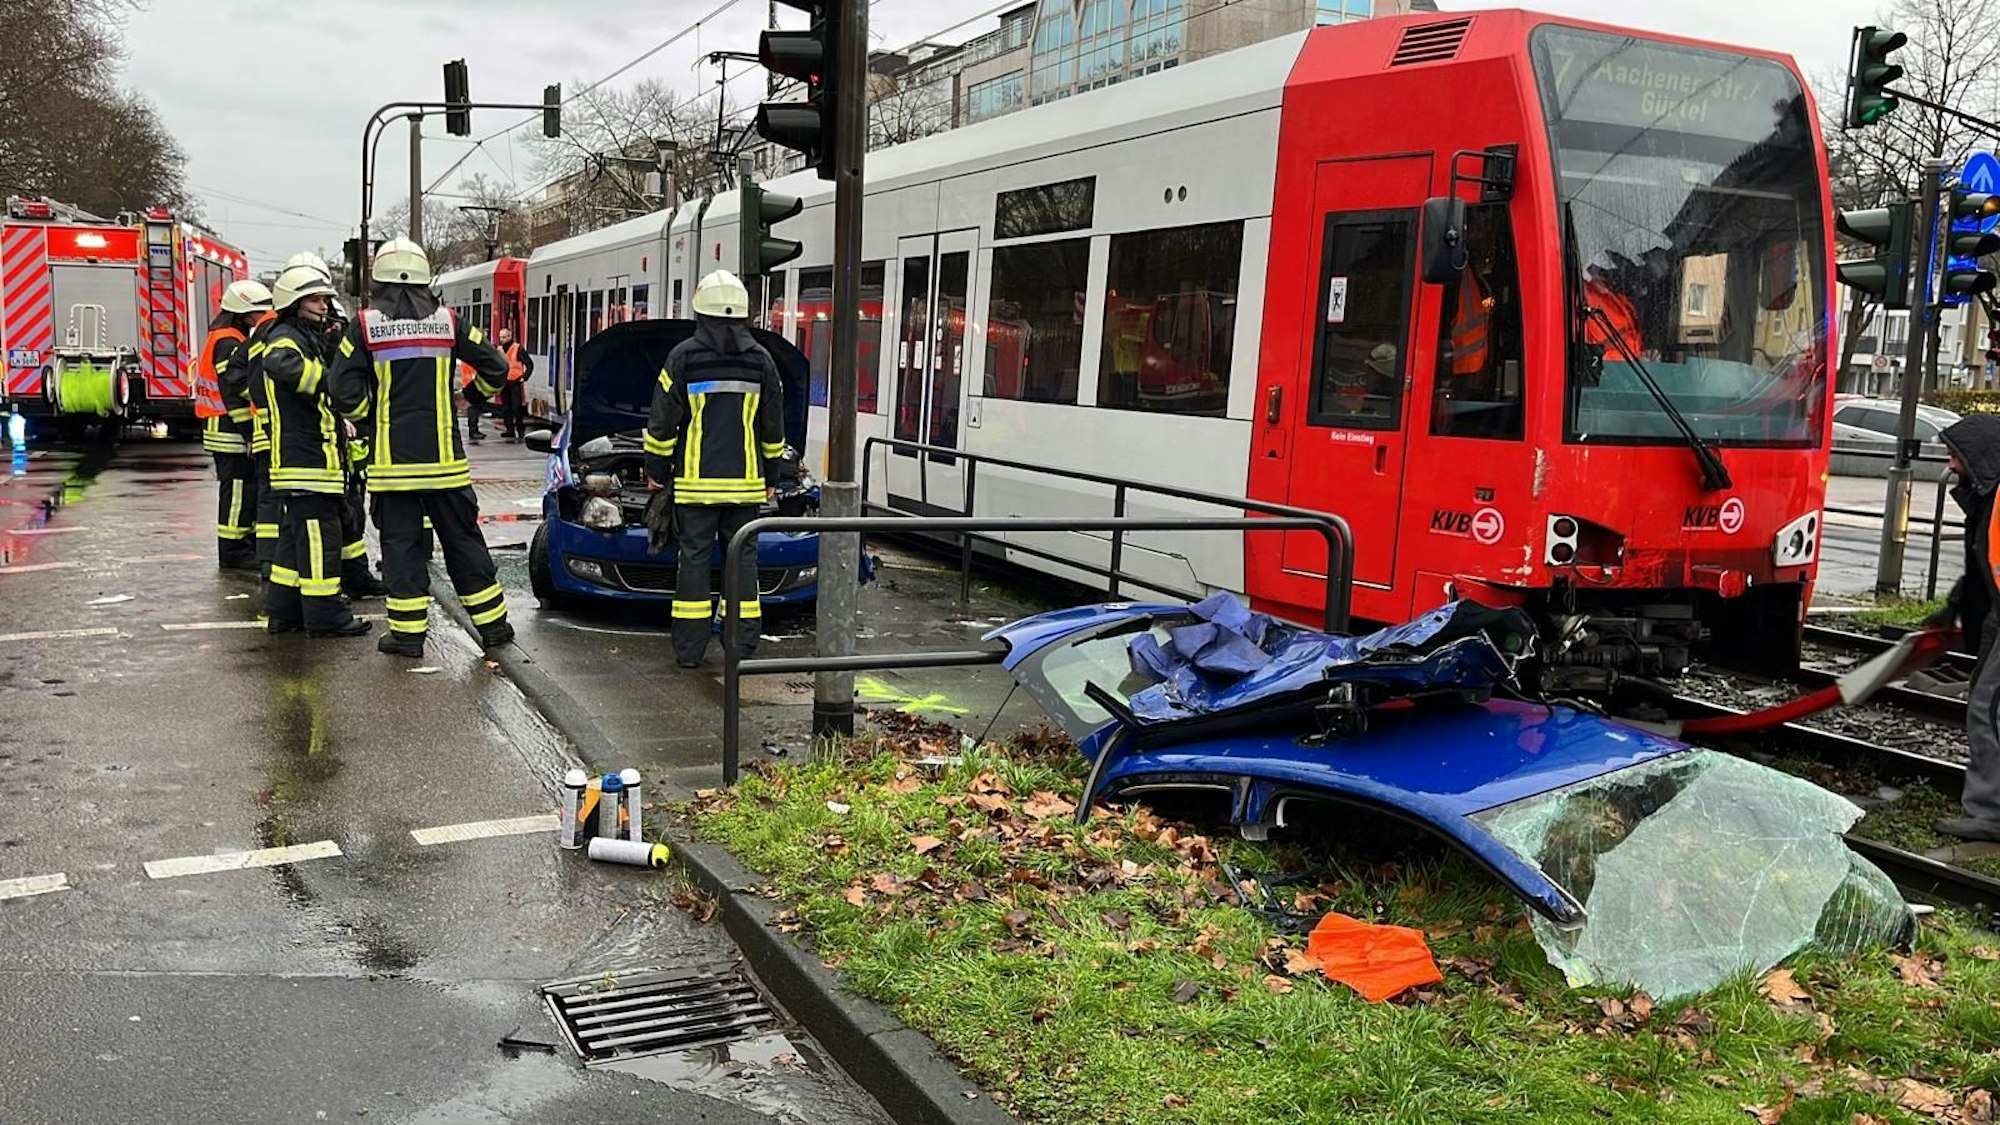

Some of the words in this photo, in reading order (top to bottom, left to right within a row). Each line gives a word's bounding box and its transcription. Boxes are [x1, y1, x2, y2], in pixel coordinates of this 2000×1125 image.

[1551, 51, 1575, 91] 7
[1594, 60, 1702, 93] Aachener
[1641, 92, 1708, 120] Gürtel
[370, 323, 450, 338] BERUFSFEUERWEHR
[1430, 509, 1472, 533] KVB
[1683, 506, 1720, 527] KVB
